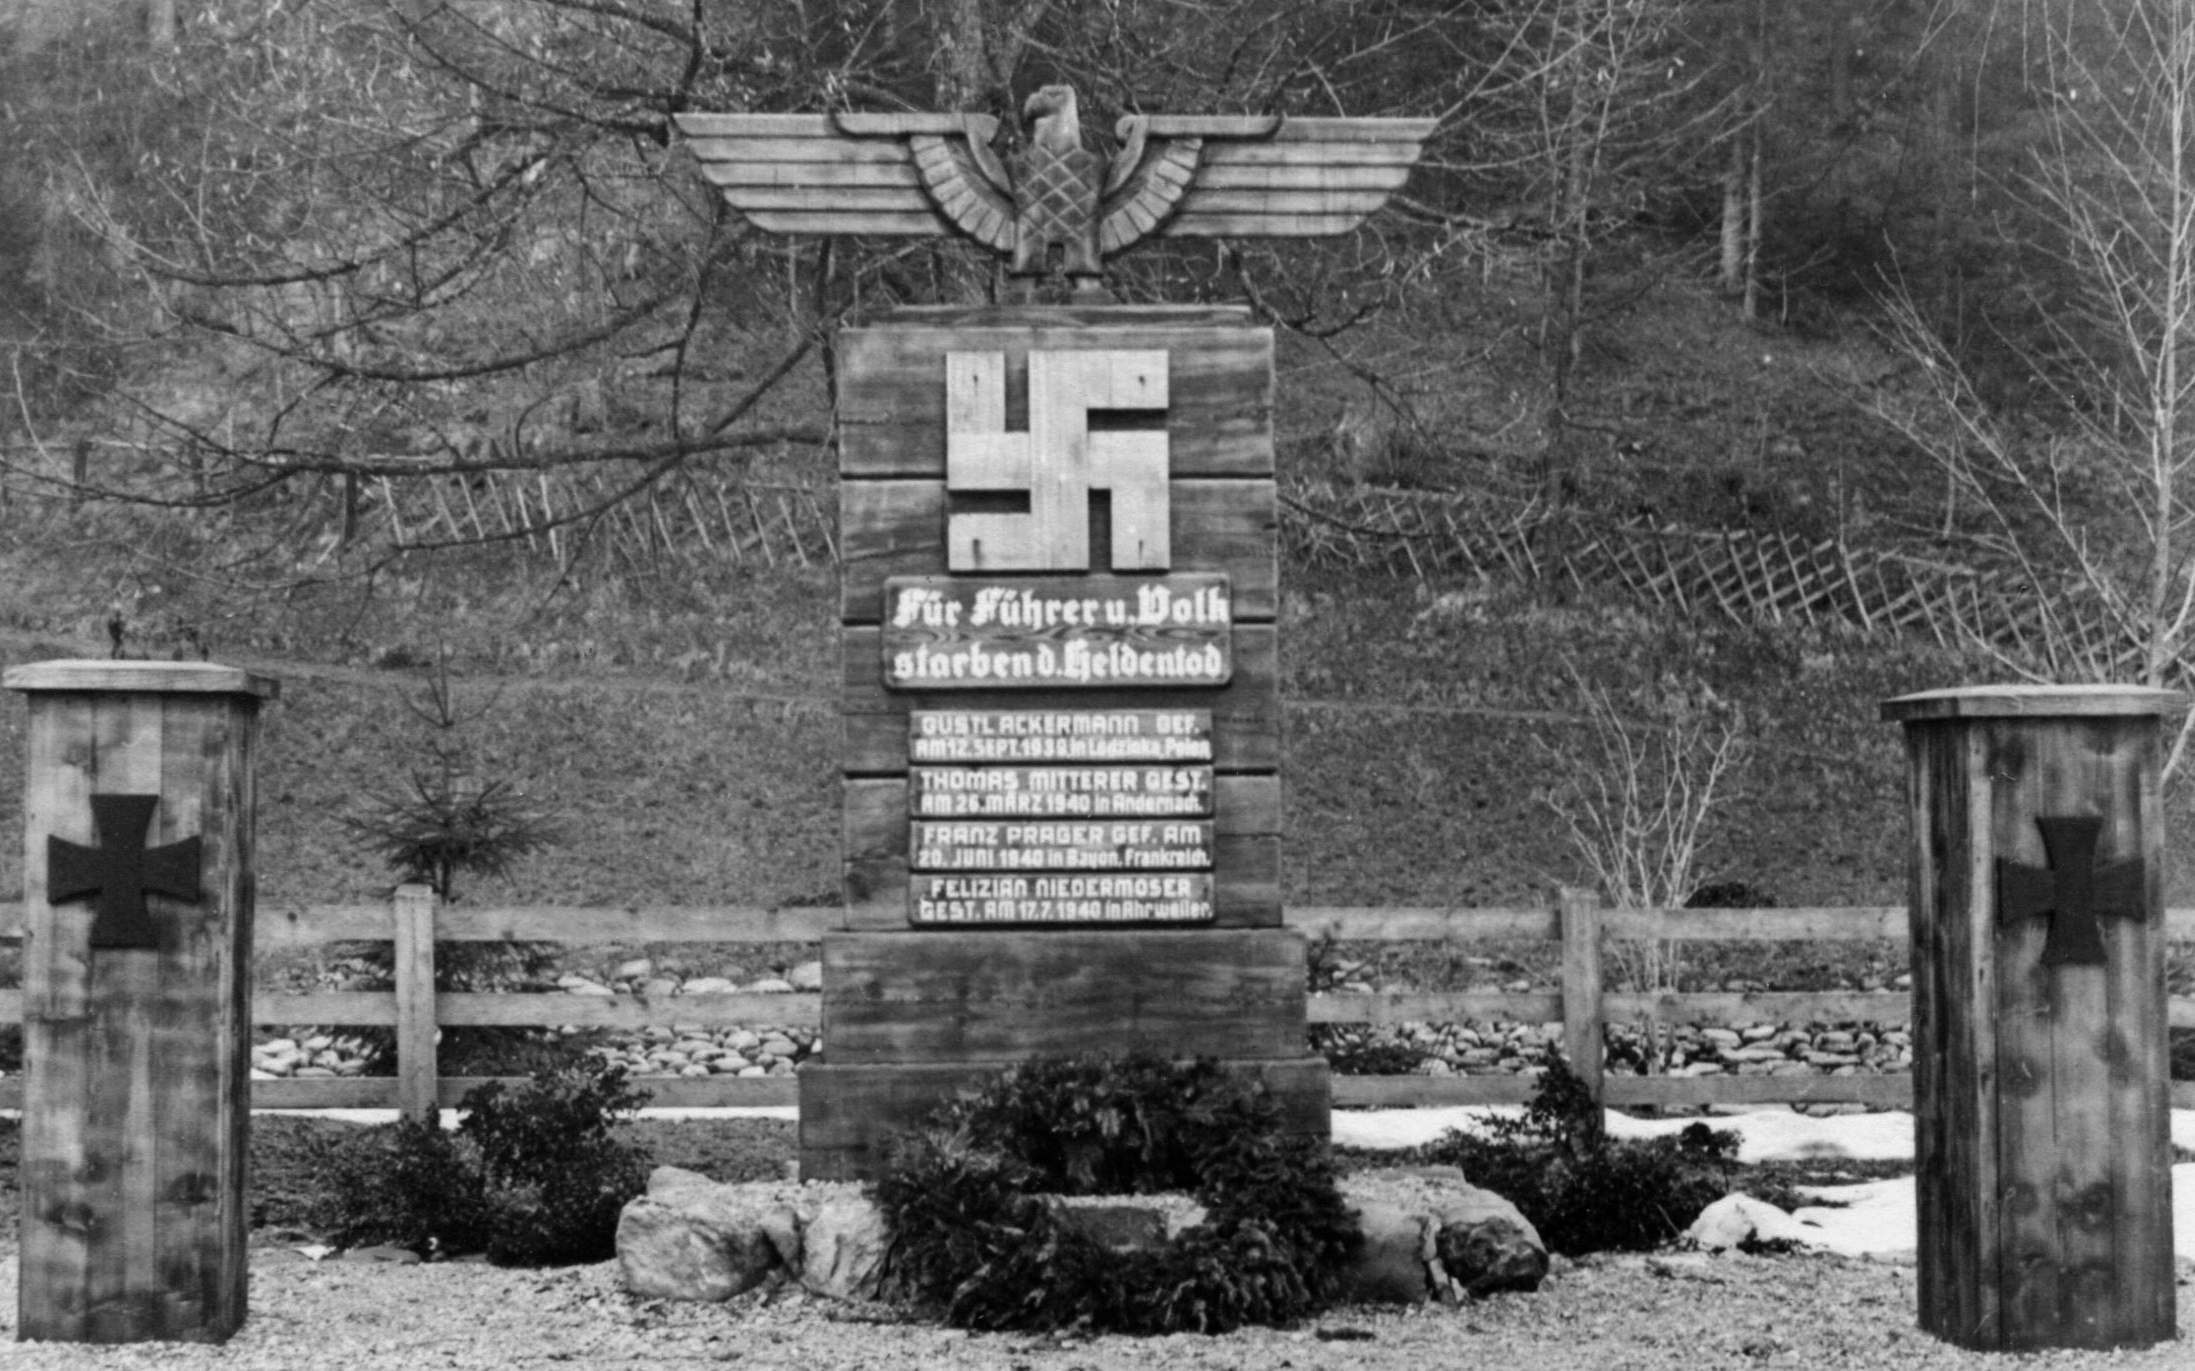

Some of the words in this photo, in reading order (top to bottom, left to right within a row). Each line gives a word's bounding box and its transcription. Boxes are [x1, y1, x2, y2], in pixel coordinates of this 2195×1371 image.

[893, 587, 961, 627] Für
[970, 587, 1098, 630] Führer
[1137, 584, 1229, 625] Volk
[894, 641, 1031, 679] starben
[1064, 638, 1221, 682] Heldentod
[921, 715, 994, 735] GUSTL
[1000, 715, 1139, 735] ACKERMANN
[1156, 715, 1200, 734] GEF.
[921, 770, 1017, 790] THOMAS
[1028, 770, 1136, 790] MITTERER
[1145, 769, 1207, 790] GEST.
[921, 795, 951, 812] AM
[1047, 794, 1090, 811] 1940
[1095, 793, 1109, 812] in
[923, 826, 998, 844] FRANZ
[1006, 825, 1103, 844] PRAGER
[1111, 825, 1157, 844] GEF.
[1163, 825, 1201, 844] AM
[952, 848, 994, 867] JUNI
[999, 848, 1043, 867] 1940
[1047, 848, 1063, 867] in
[931, 878, 1027, 898] FELIZIAN
[1035, 878, 1191, 898] NIEDERMOSER
[919, 900, 981, 920] GEST.
[984, 901, 1015, 920] AM
[1057, 901, 1101, 919] 1940
